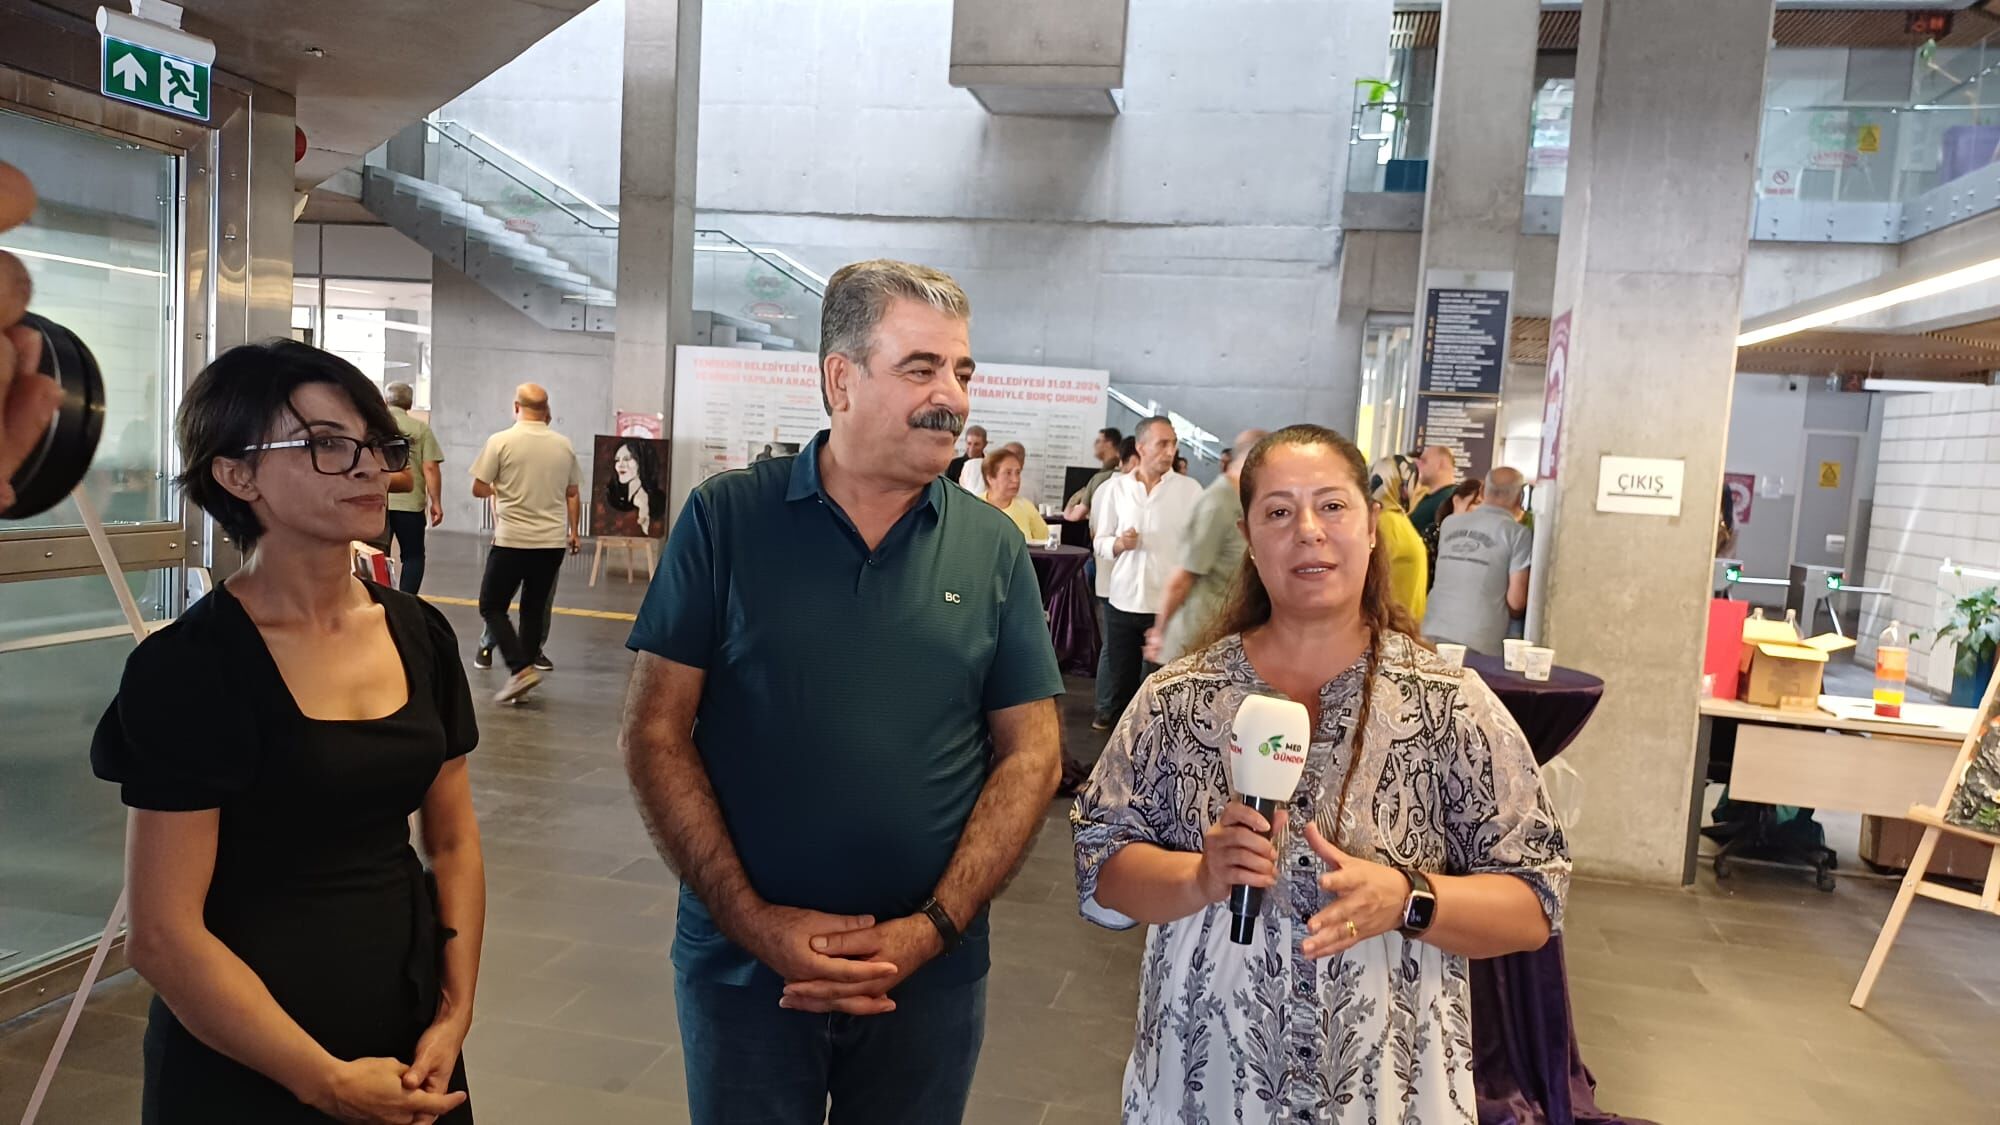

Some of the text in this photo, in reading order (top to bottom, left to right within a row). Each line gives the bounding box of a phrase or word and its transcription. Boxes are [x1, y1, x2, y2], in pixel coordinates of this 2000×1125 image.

[744, 360, 800, 373] BELEDİYESİ
[987, 375, 1045, 387] BELEDİYESİ
[1047, 380, 1101, 391] 31.03.2024
[1026, 392, 1053, 404] BORÇ
[1056, 393, 1098, 405] DURUMU
[1617, 473, 1664, 493] ÇIKIŞ
[945, 591, 961, 604] BC
[1285, 742, 1302, 752] MED
[1273, 753, 1304, 764] GÜNDEM
